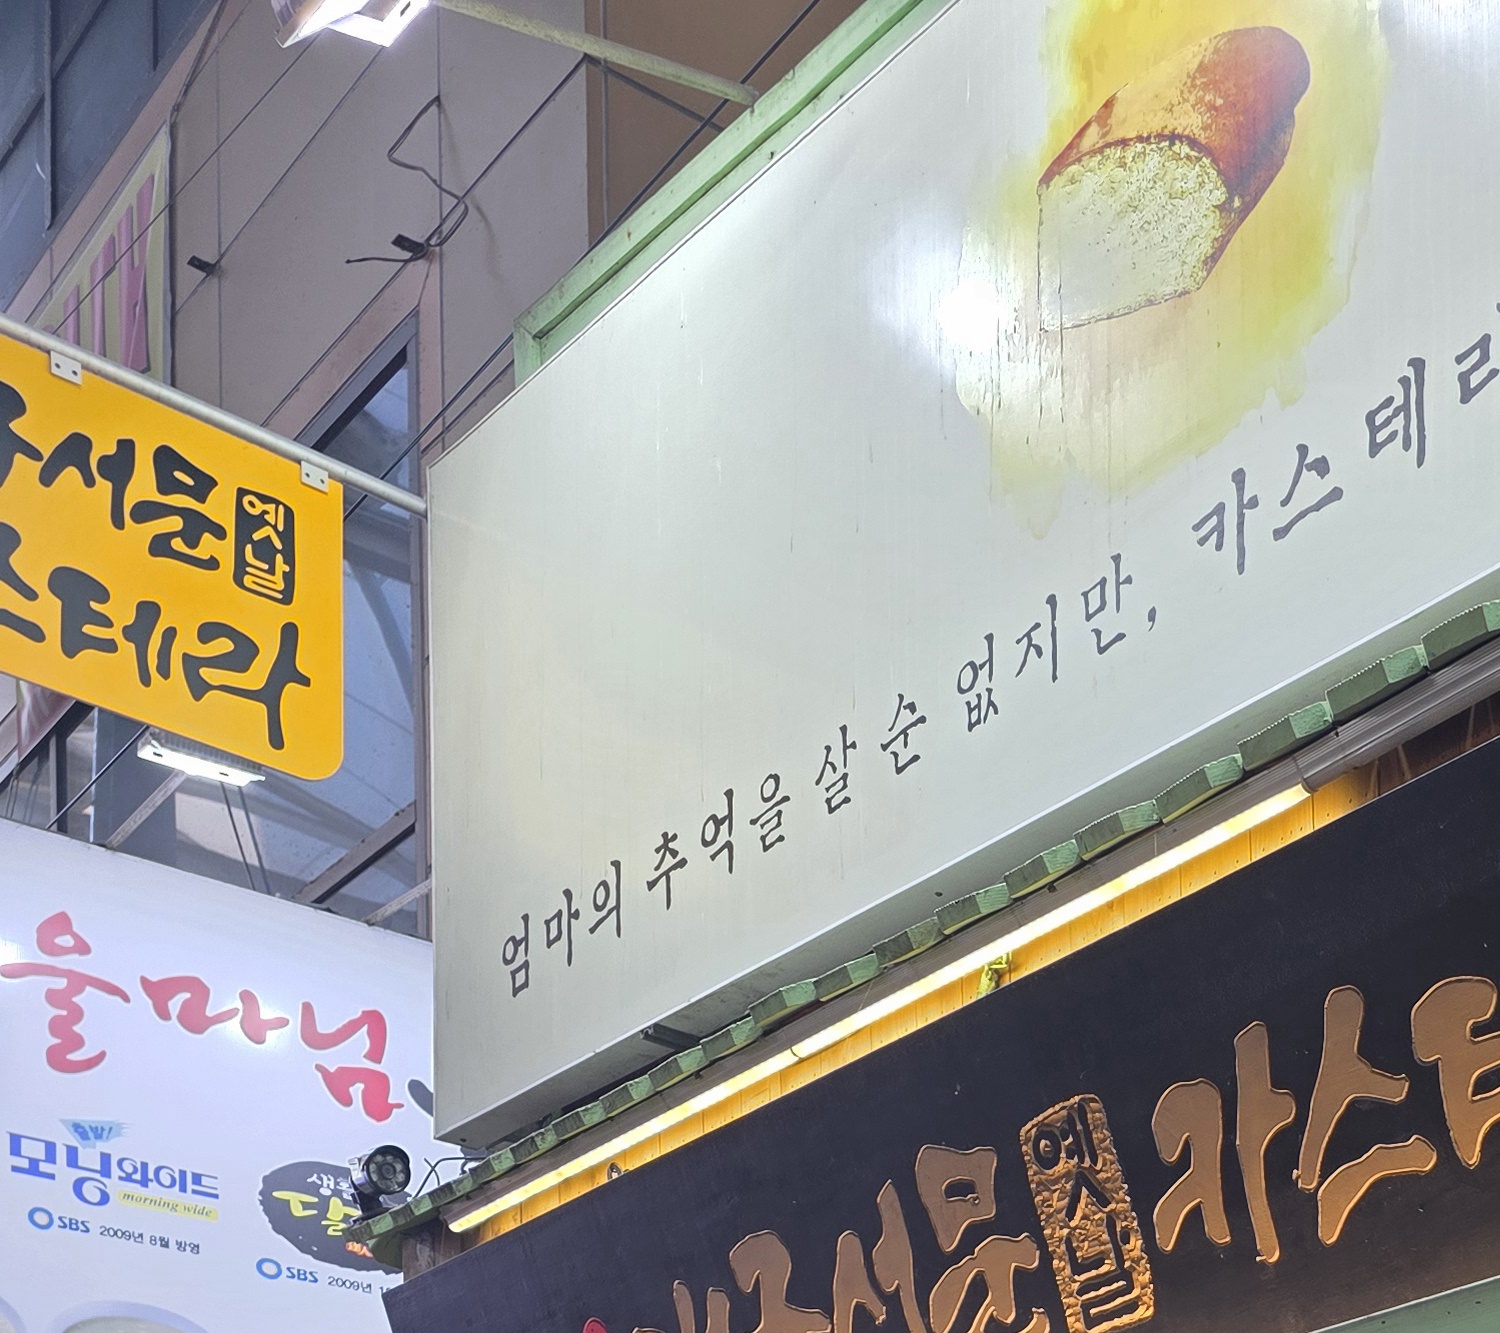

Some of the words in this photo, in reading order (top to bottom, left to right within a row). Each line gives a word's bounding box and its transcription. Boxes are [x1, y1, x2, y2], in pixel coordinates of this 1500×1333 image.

[500, 859, 622, 998] 엄마의
[646, 771, 792, 911] 추억을
[814, 725, 857, 815] 살
[880, 692, 927, 776] 순
[955, 553, 1158, 734] 없지만,
[6, 1131, 220, 1207] 모닝와이드
[122, 1192, 179, 1213] morning
[183, 1204, 213, 1218] wide
[57, 1215, 90, 1234] SBS
[99, 1225, 144, 1244] 2009년
[149, 1235, 170, 1249] 8월
[175, 1239, 200, 1255] 방영
[286, 1266, 318, 1284] SBS
[328, 1276, 372, 1294] 2009년
